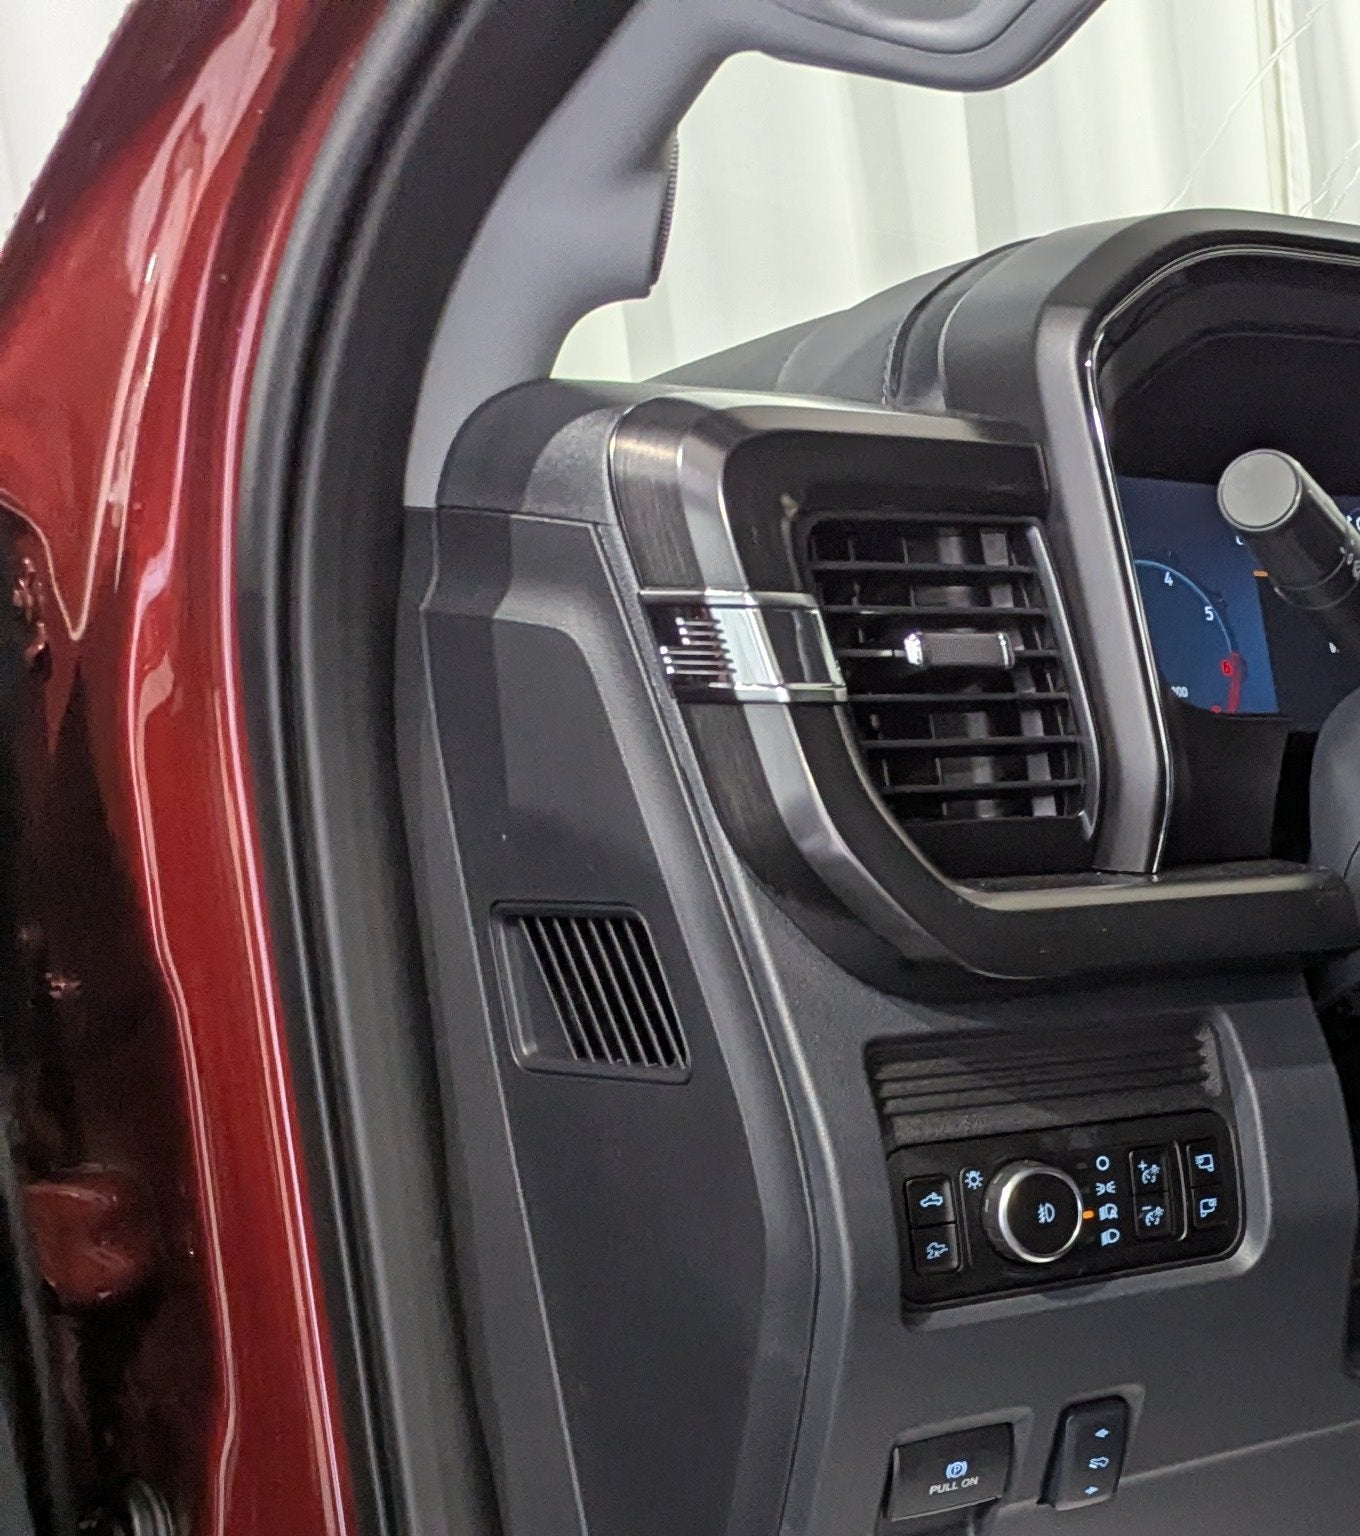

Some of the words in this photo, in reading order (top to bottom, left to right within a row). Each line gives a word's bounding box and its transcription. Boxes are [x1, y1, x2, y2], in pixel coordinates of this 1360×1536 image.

[1163, 571, 1174, 587] 4
[1204, 605, 1214, 622] 5
[1220, 659, 1233, 677] 6
[928, 1481, 958, 1496] PULL
[961, 1476, 979, 1488] ON
